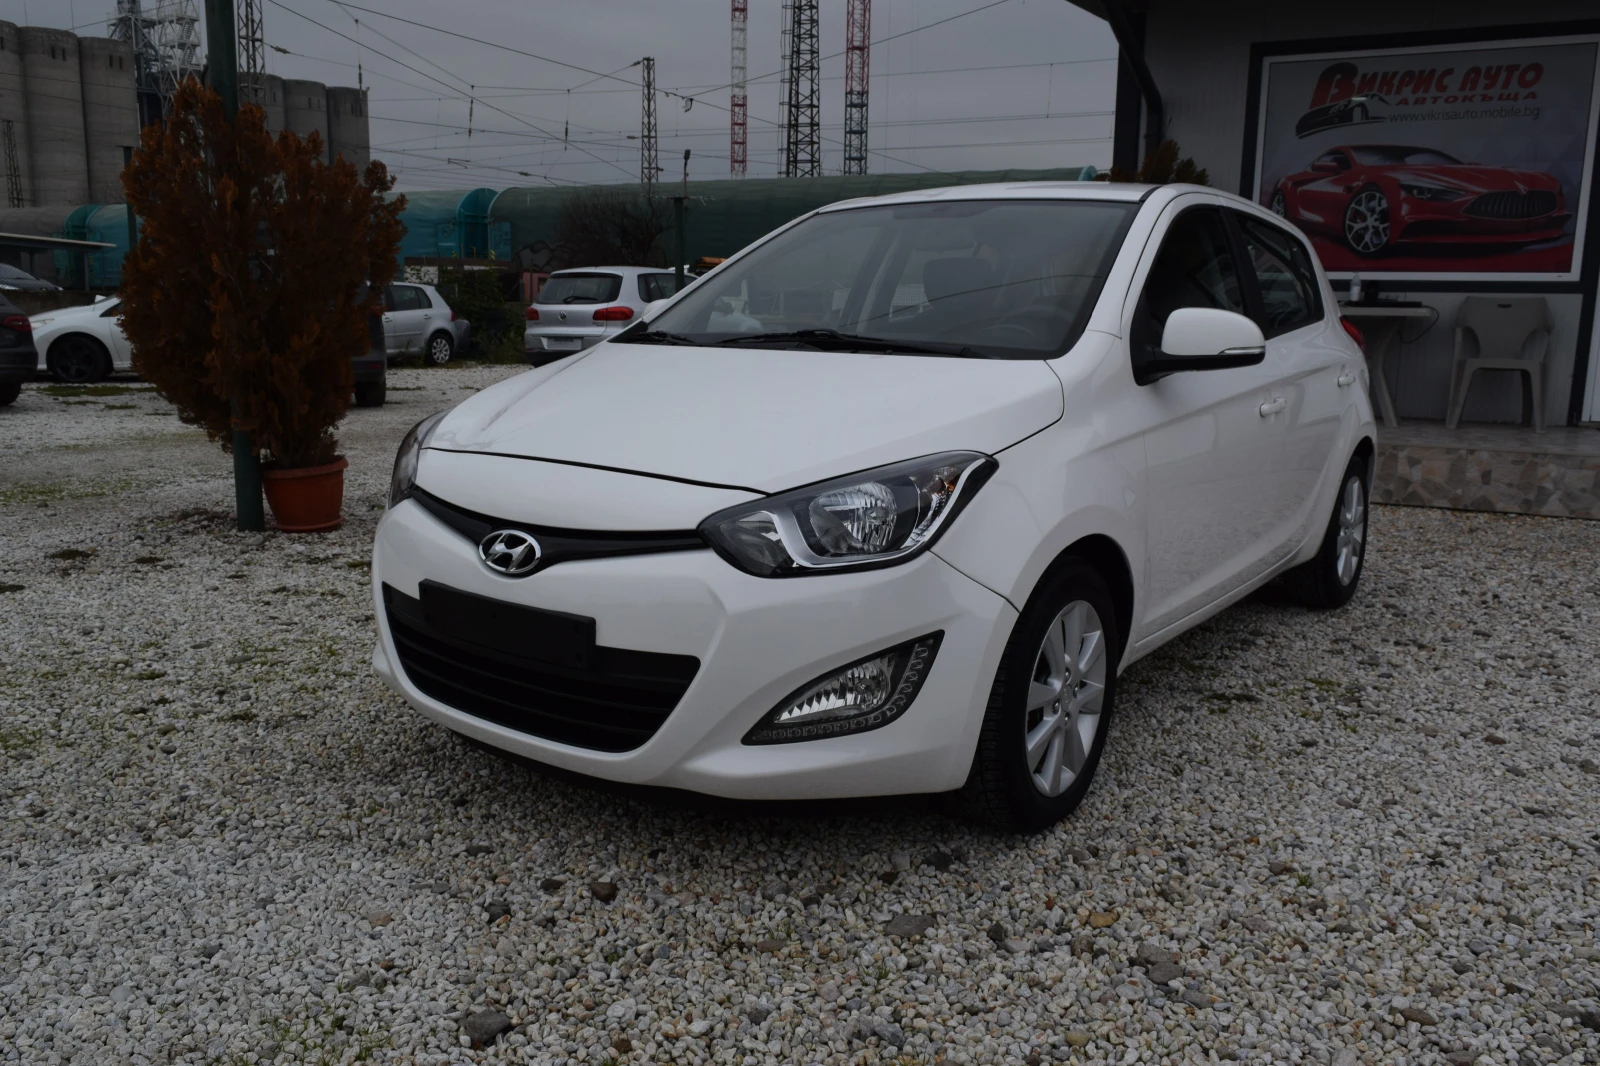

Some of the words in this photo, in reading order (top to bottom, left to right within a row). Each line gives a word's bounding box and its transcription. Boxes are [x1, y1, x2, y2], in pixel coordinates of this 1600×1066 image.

[1459, 62, 1544, 92] АУТО
[1395, 91, 1538, 106] АВТОКЪЩА
[1389, 106, 1540, 123] www.vikrisauto.mobile.bg
